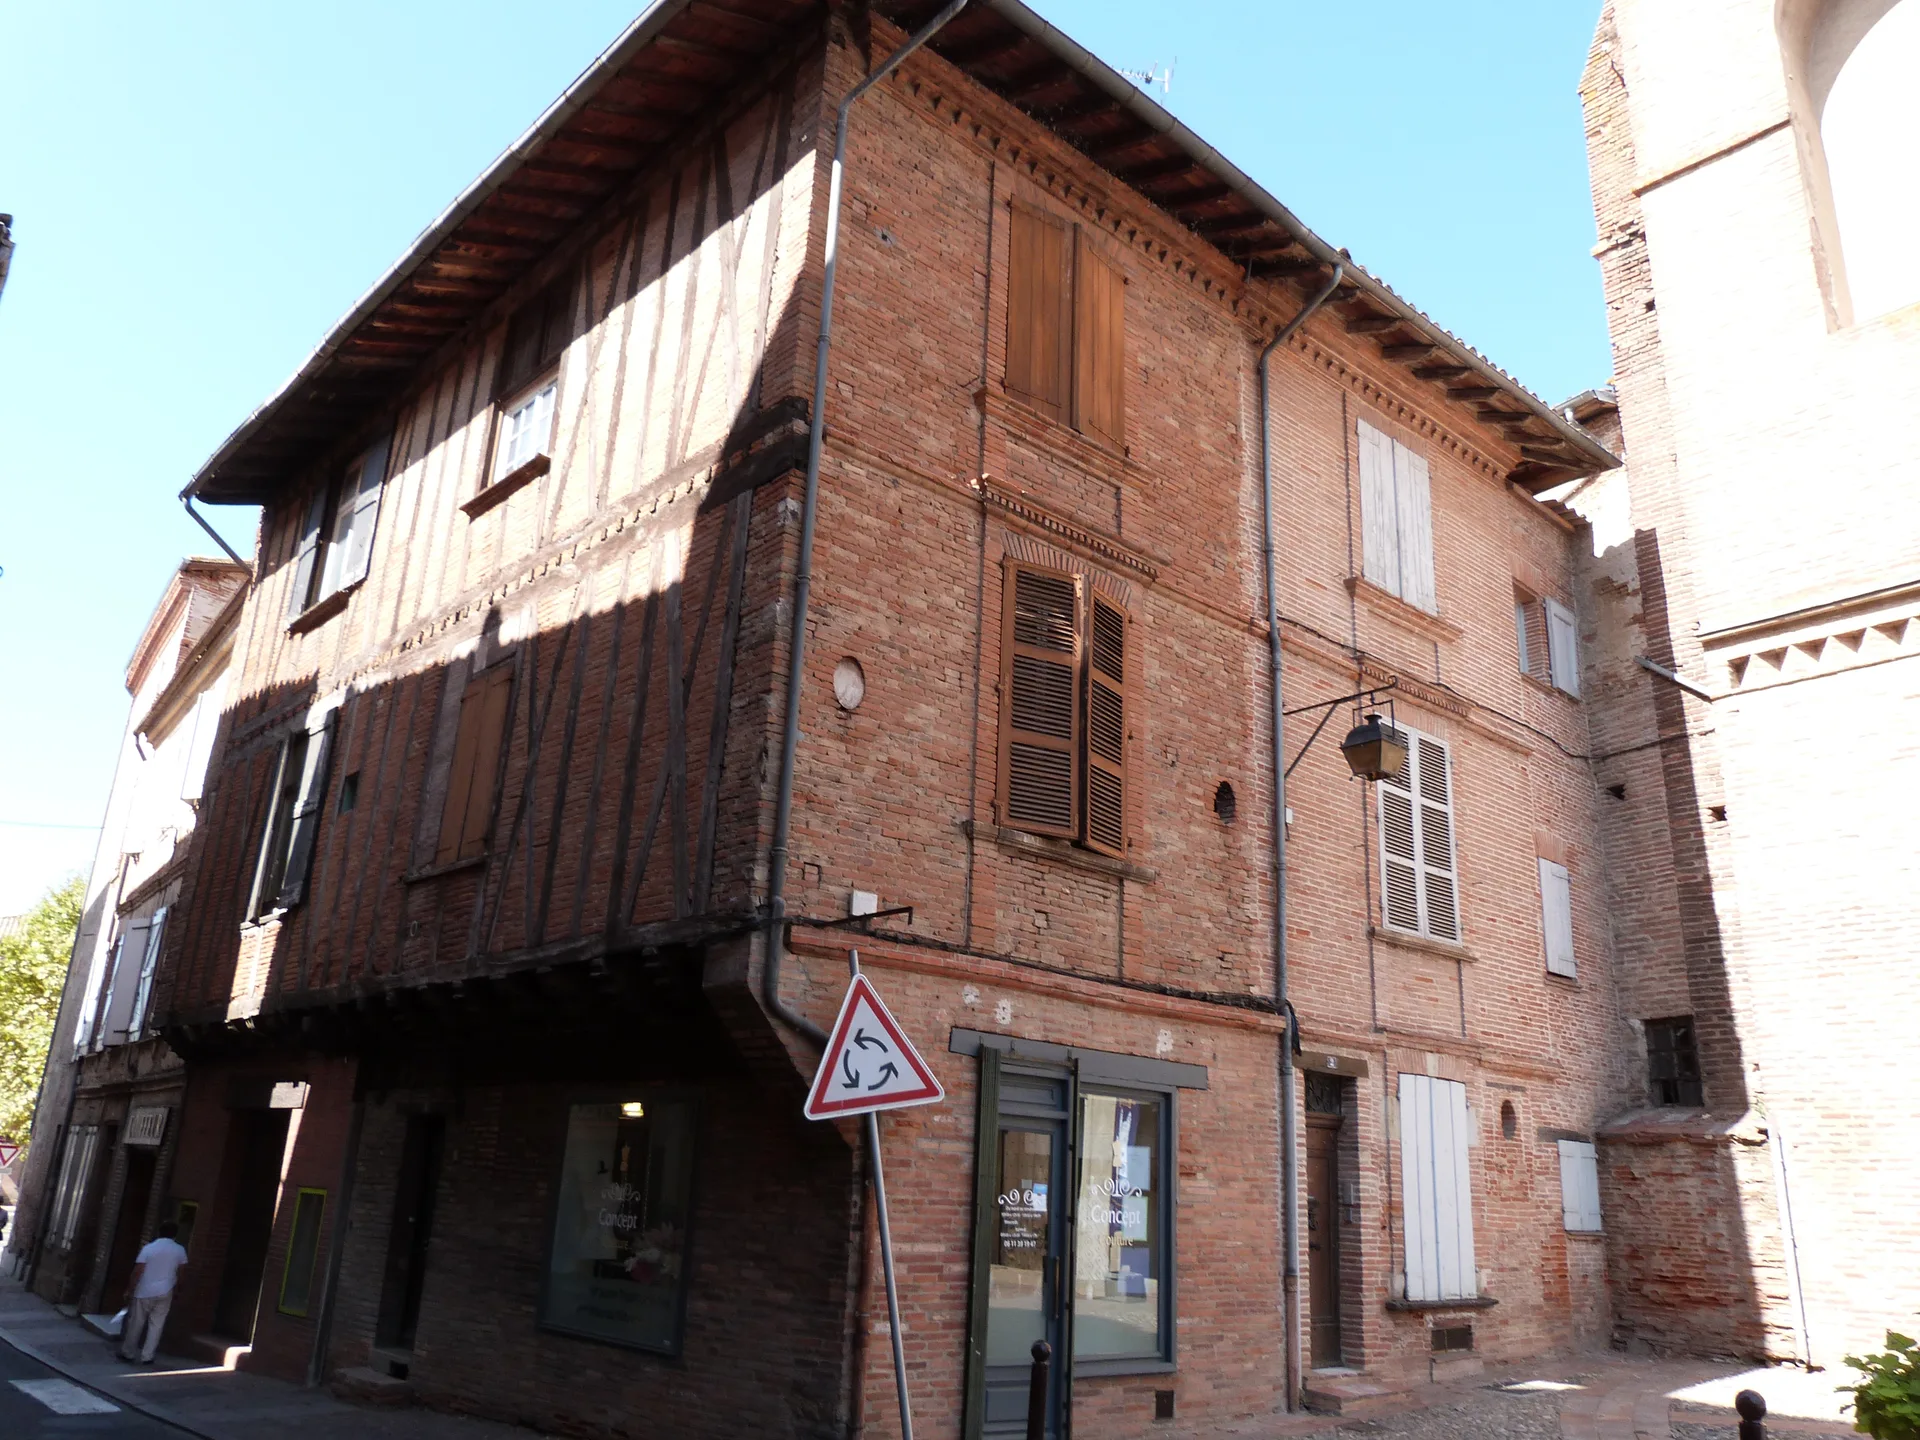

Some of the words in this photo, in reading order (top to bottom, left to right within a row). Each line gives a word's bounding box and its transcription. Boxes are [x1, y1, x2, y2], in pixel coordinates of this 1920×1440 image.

[599, 1207, 638, 1231] Concept
[1091, 1204, 1141, 1228] Concept
[1101, 1235, 1134, 1246] outure
